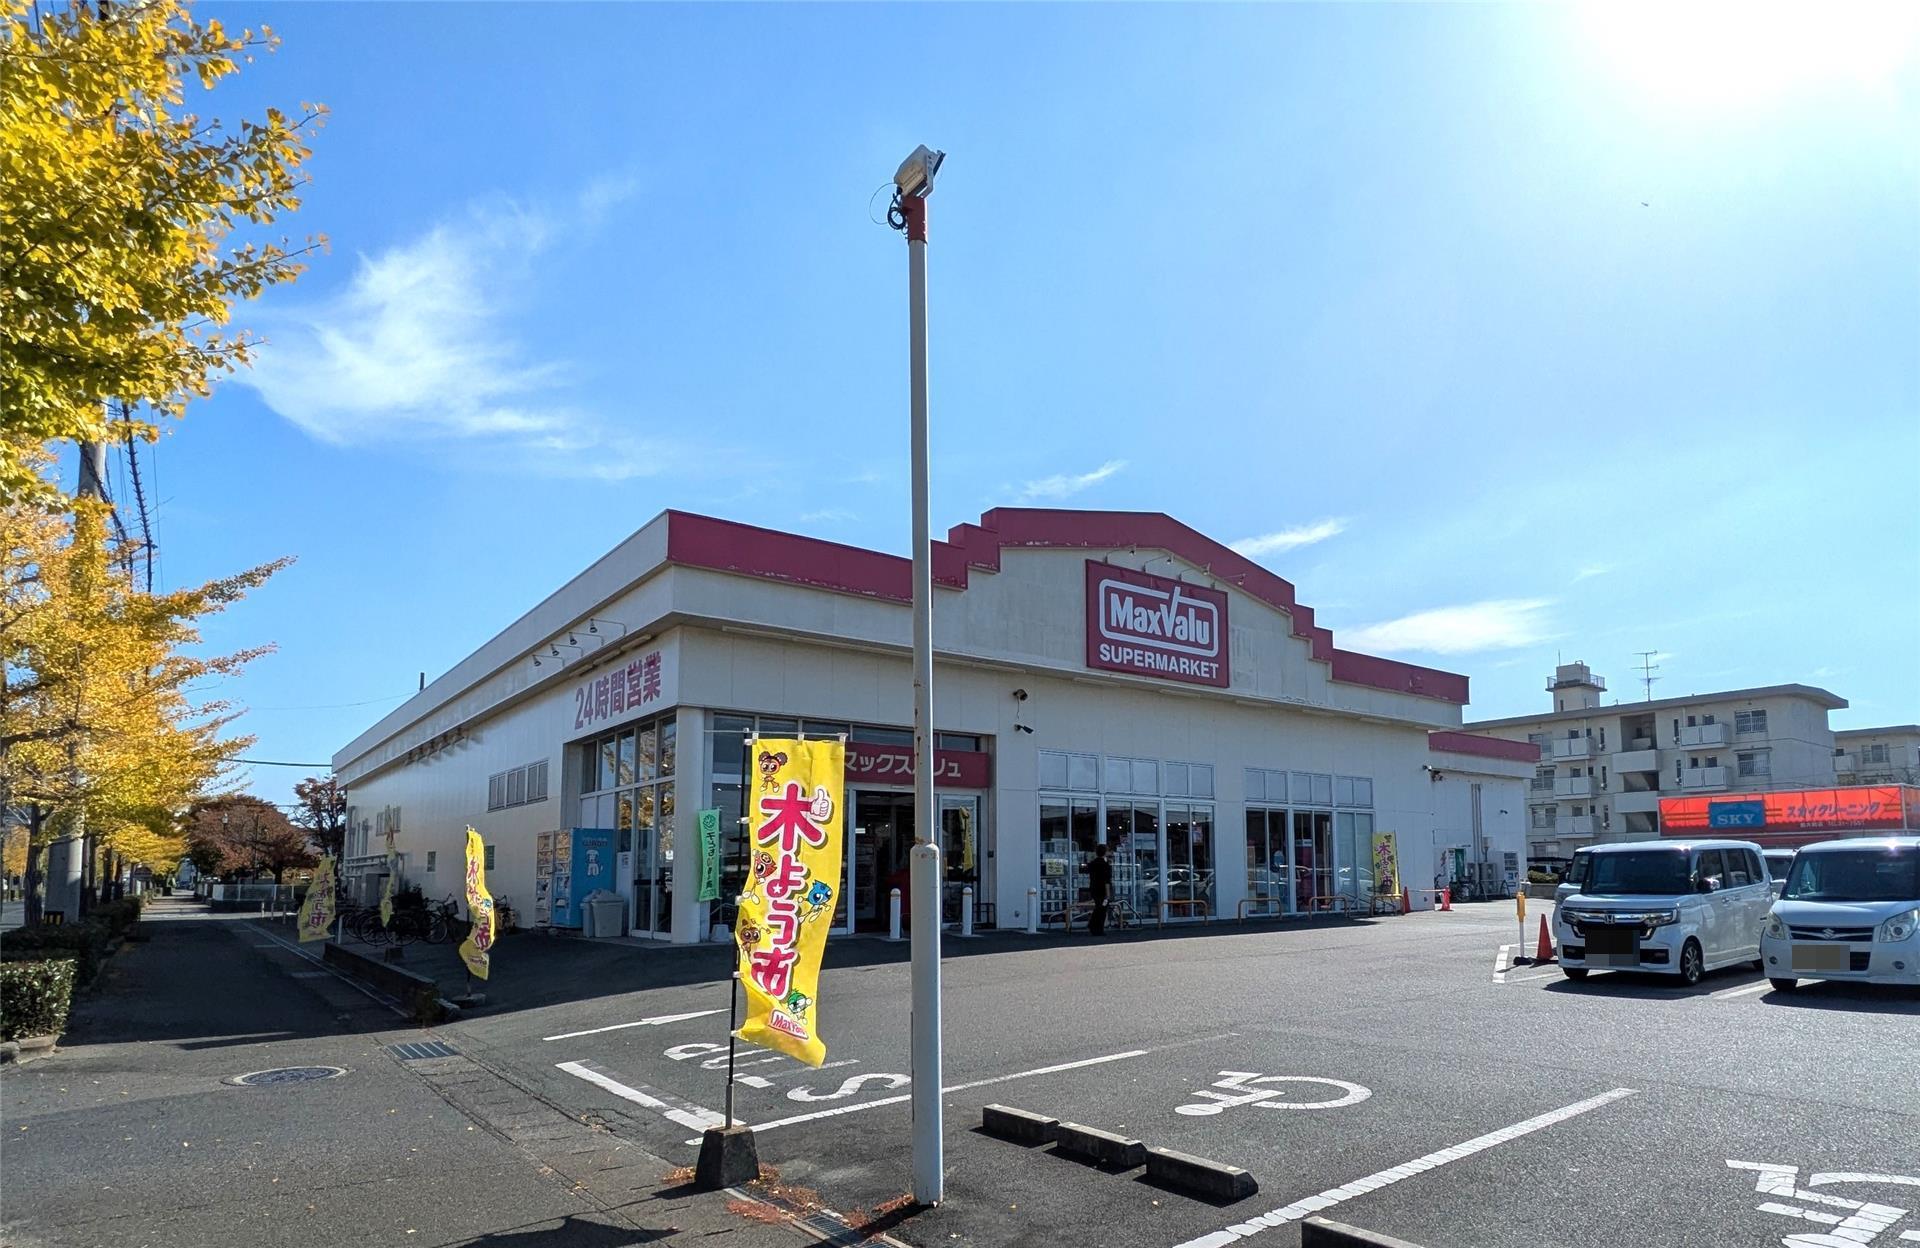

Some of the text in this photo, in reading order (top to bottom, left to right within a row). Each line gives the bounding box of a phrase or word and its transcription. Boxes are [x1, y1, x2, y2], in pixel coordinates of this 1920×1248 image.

[1111, 587, 1209, 645] MaxValu
[1100, 644, 1219, 679] SUPERMARKET
[575, 651, 661, 730] 24時間営業
[845, 751, 961, 777] マックスリュ
[1717, 814, 1755, 825] SKY
[1787, 801, 1881, 818] スカイクリーニング
[751, 783, 823, 997] 木よう市
